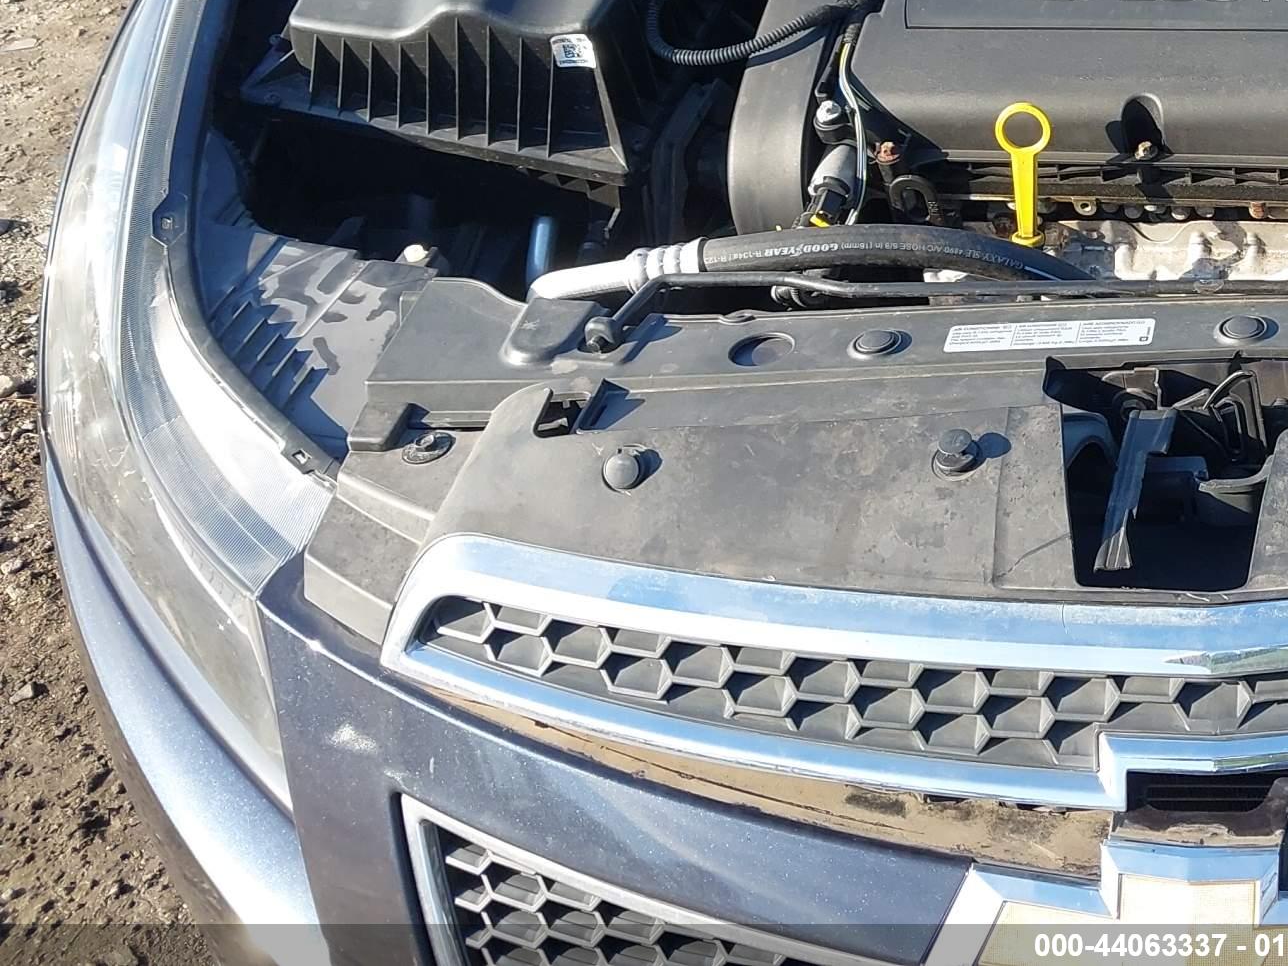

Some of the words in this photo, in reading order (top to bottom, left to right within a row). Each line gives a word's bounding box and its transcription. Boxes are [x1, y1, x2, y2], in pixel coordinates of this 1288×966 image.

[763, 242, 839, 258] GOODYEAR
[900, 242, 924, 251] HOSE
[927, 245, 942, 253] A/C
[984, 252, 1024, 270] GALAXY
